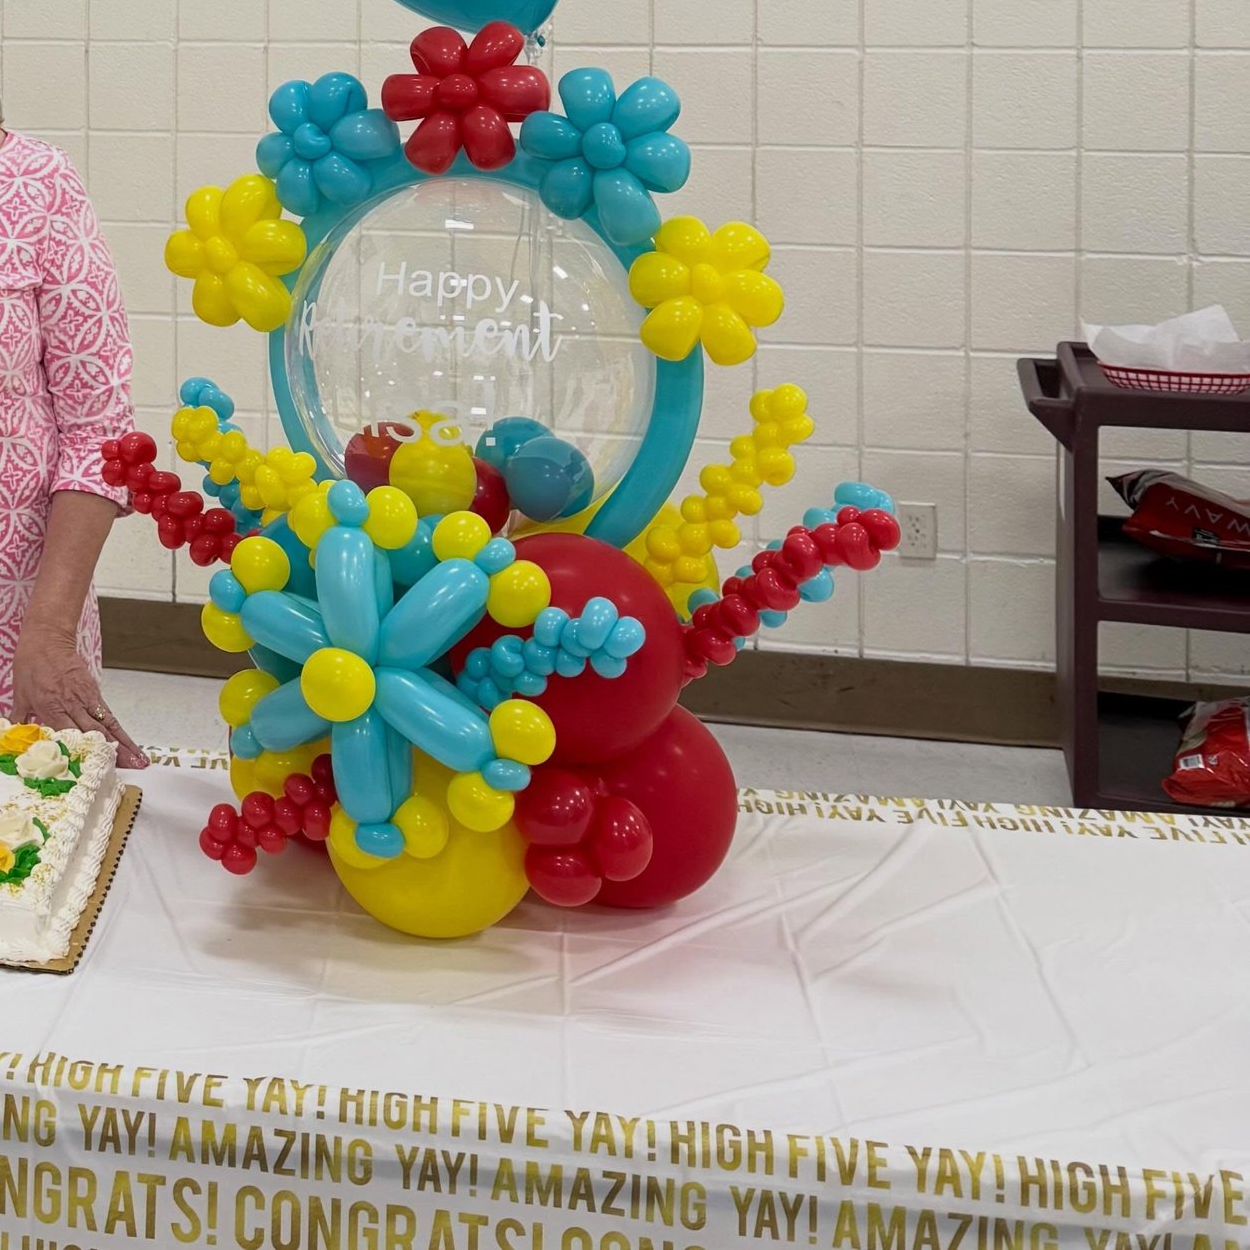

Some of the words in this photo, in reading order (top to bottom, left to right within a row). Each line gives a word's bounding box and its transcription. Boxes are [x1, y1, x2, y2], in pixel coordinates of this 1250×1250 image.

[375, 261, 520, 313] Happy
[892, 807, 969, 827] FIVE
[27, 1051, 124, 1096] HIGH
[131, 1066, 229, 1108] FIVE
[242, 1076, 328, 1120] YAY!
[338, 1087, 439, 1135] HIGH
[451, 1099, 549, 1149] FIVE
[563, 1109, 656, 1161] YAY!
[669, 1119, 774, 1176] HIGH
[788, 1134, 891, 1190] FIVE
[903, 1144, 1005, 1204] YAY!
[1017, 1155, 1131, 1218] HIGH
[1142, 1168, 1249, 1226] FIVE
[78, 1105, 155, 1155] YAY!
[170, 1117, 374, 1185] AMAZING
[395, 1146, 477, 1196] YAY!
[490, 1159, 707, 1229] AMAZING
[729, 1187, 817, 1244] YAY!
